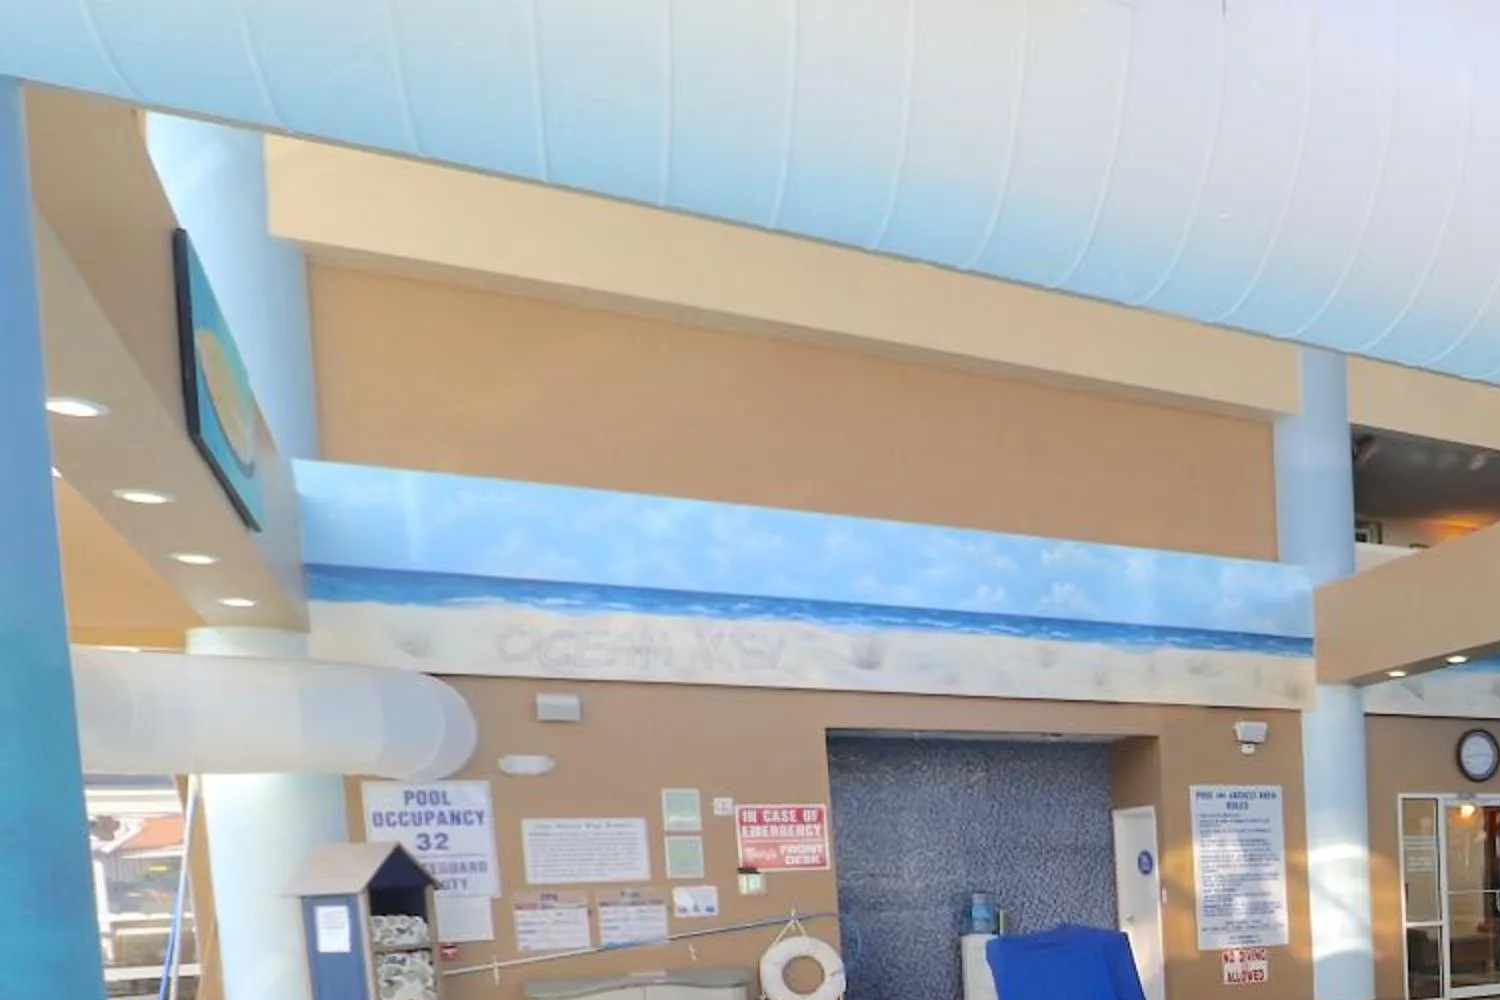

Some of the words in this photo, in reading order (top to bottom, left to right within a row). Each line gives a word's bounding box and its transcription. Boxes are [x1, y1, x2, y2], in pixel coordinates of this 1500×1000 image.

[403, 789, 452, 806] POOL
[371, 809, 485, 828] OCCUPANCY
[763, 808, 797, 823] CASE
[741, 823, 822, 838] EMERGENCY
[416, 833, 450, 852] 32
